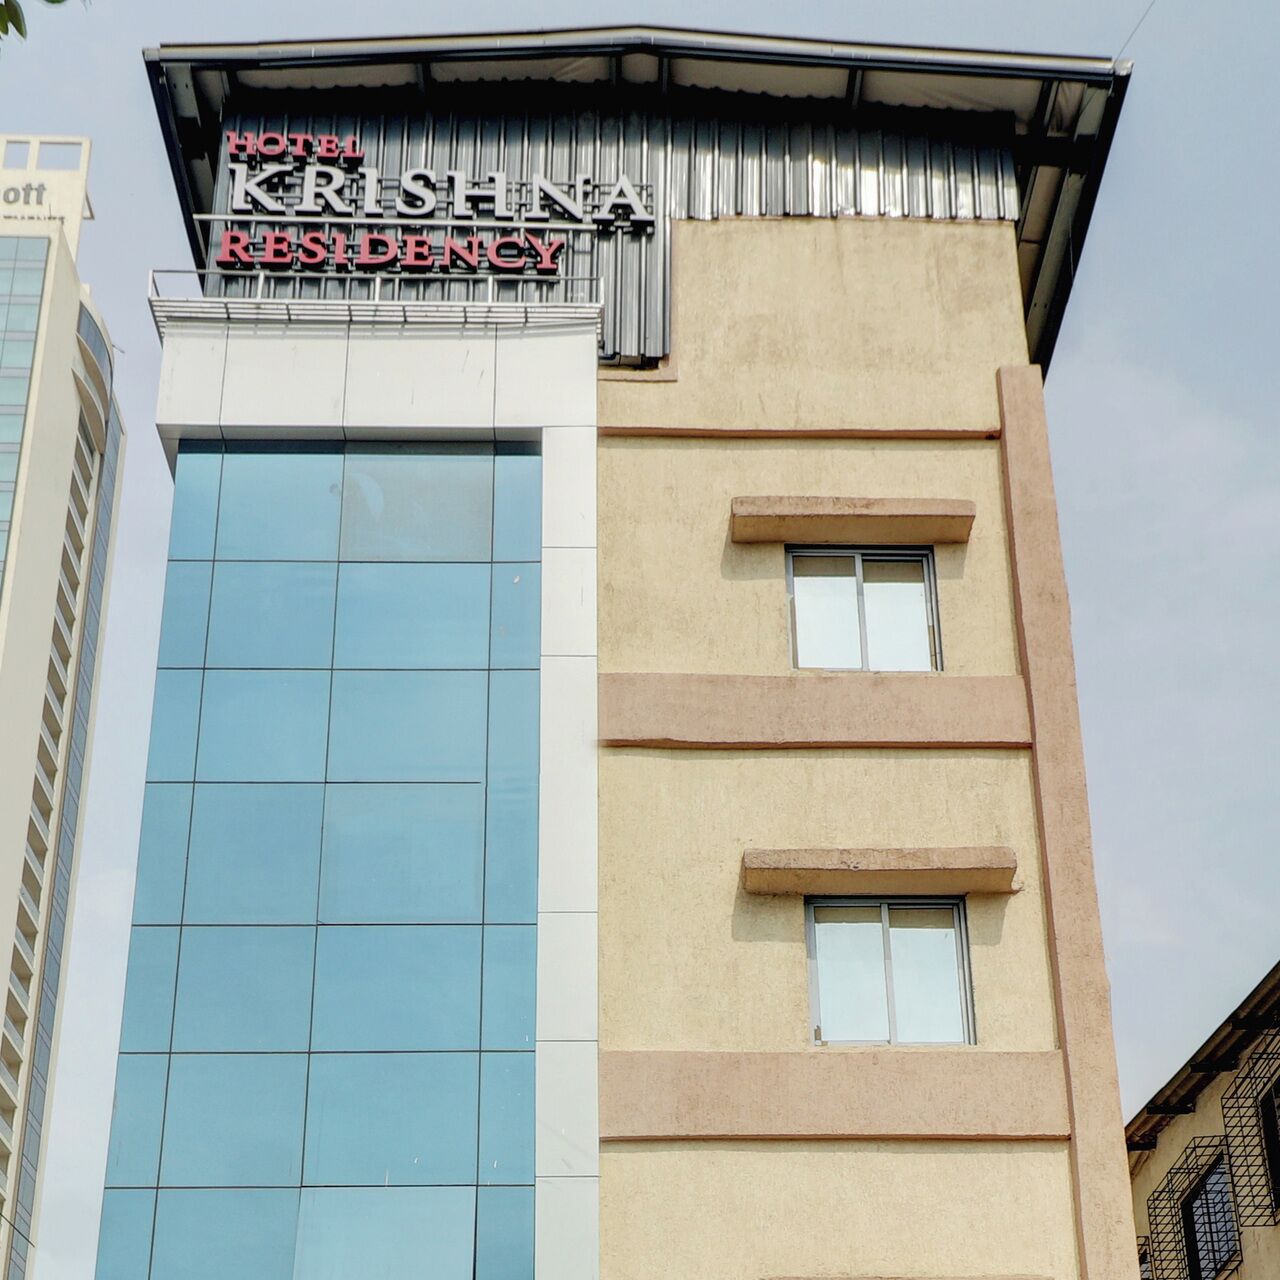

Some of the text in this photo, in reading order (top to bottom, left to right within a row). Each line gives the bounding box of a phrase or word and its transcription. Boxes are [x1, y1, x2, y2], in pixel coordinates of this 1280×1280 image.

[225, 130, 365, 158] HOTEL
[227, 162, 655, 222] KRISHNA
[218, 231, 565, 269] RESIDENCY
